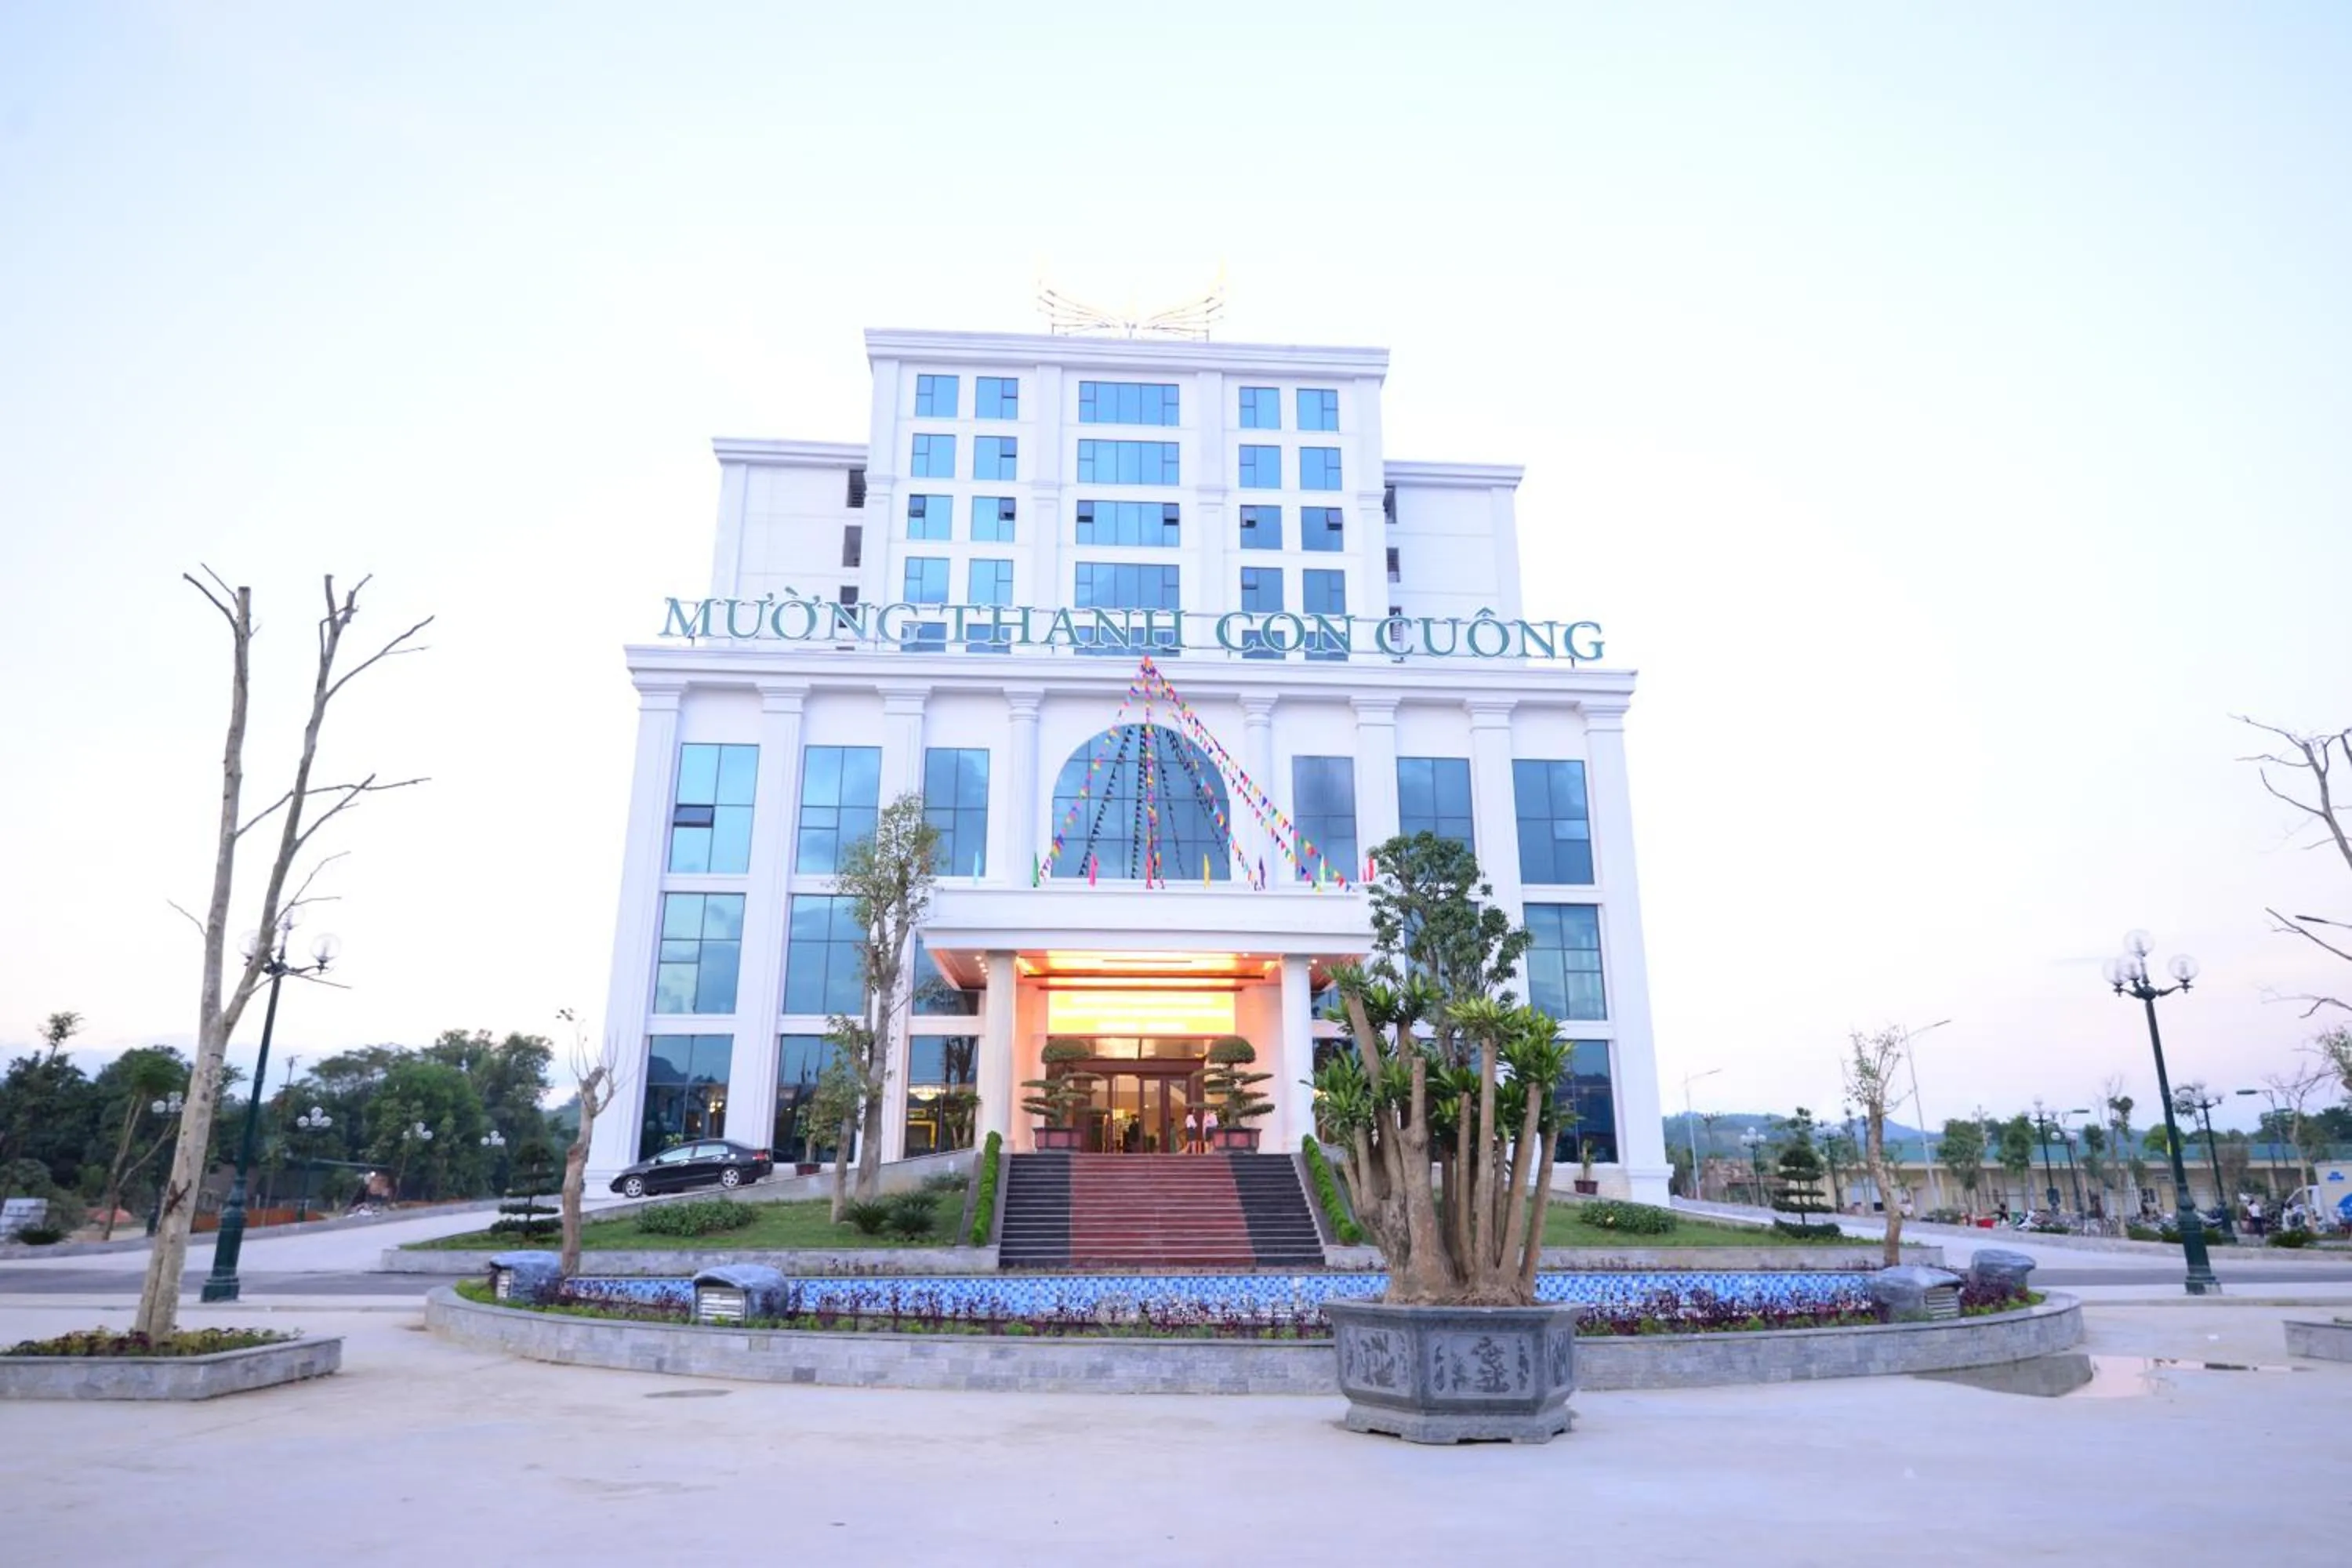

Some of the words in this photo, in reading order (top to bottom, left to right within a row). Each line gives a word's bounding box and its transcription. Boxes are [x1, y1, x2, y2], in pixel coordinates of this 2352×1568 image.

[659, 586, 922, 644] MƯỜNG
[941, 604, 1187, 650] THANH
[1216, 610, 1356, 653] CON
[1374, 607, 1606, 661] CUÔNG
